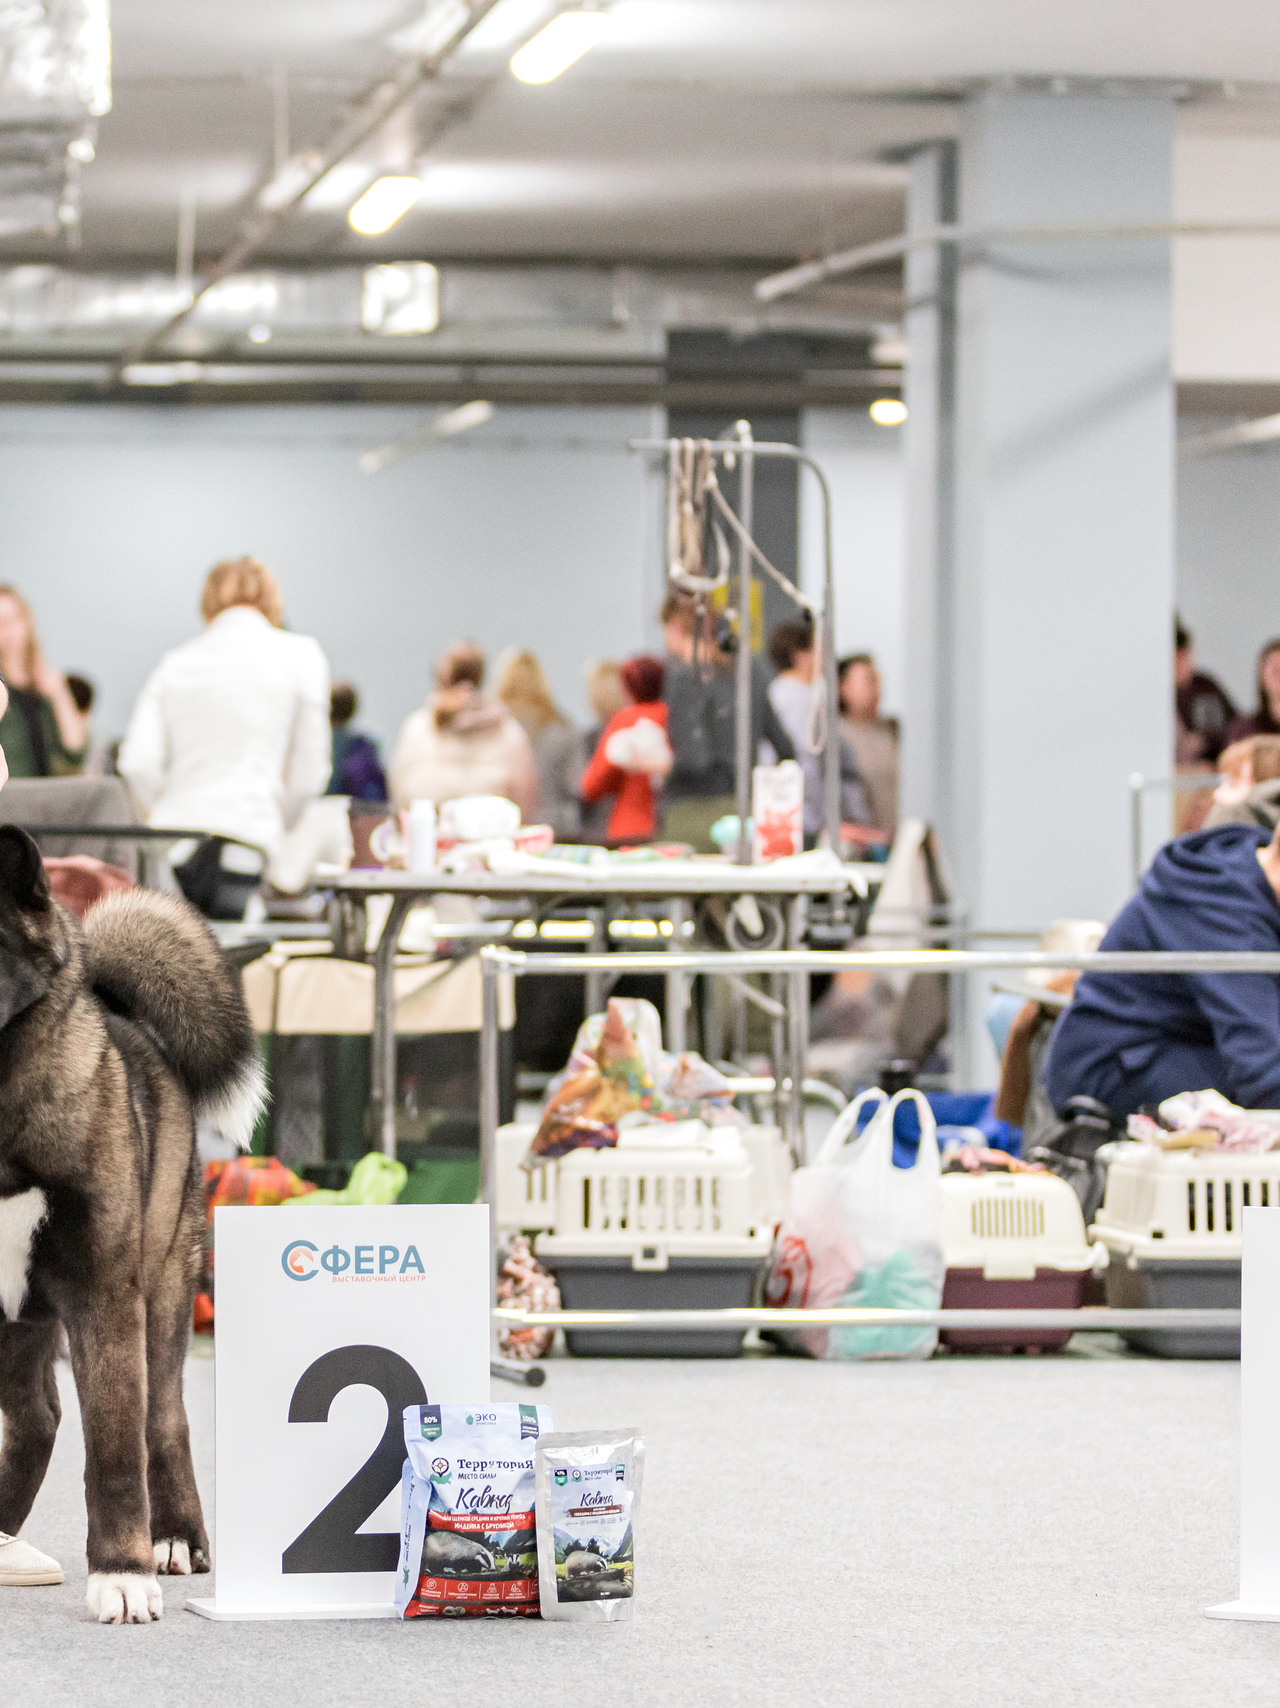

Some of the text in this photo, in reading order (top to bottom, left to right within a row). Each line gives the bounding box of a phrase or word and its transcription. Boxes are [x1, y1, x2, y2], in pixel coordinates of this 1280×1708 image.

[281, 1239, 426, 1282] СФЕРА
[332, 1274, 426, 1284] ВЫСТАВОЧНЫЙ ЦЕНТР
[475, 1413, 497, 1422] ЭКО
[281, 1344, 429, 1575] 2
